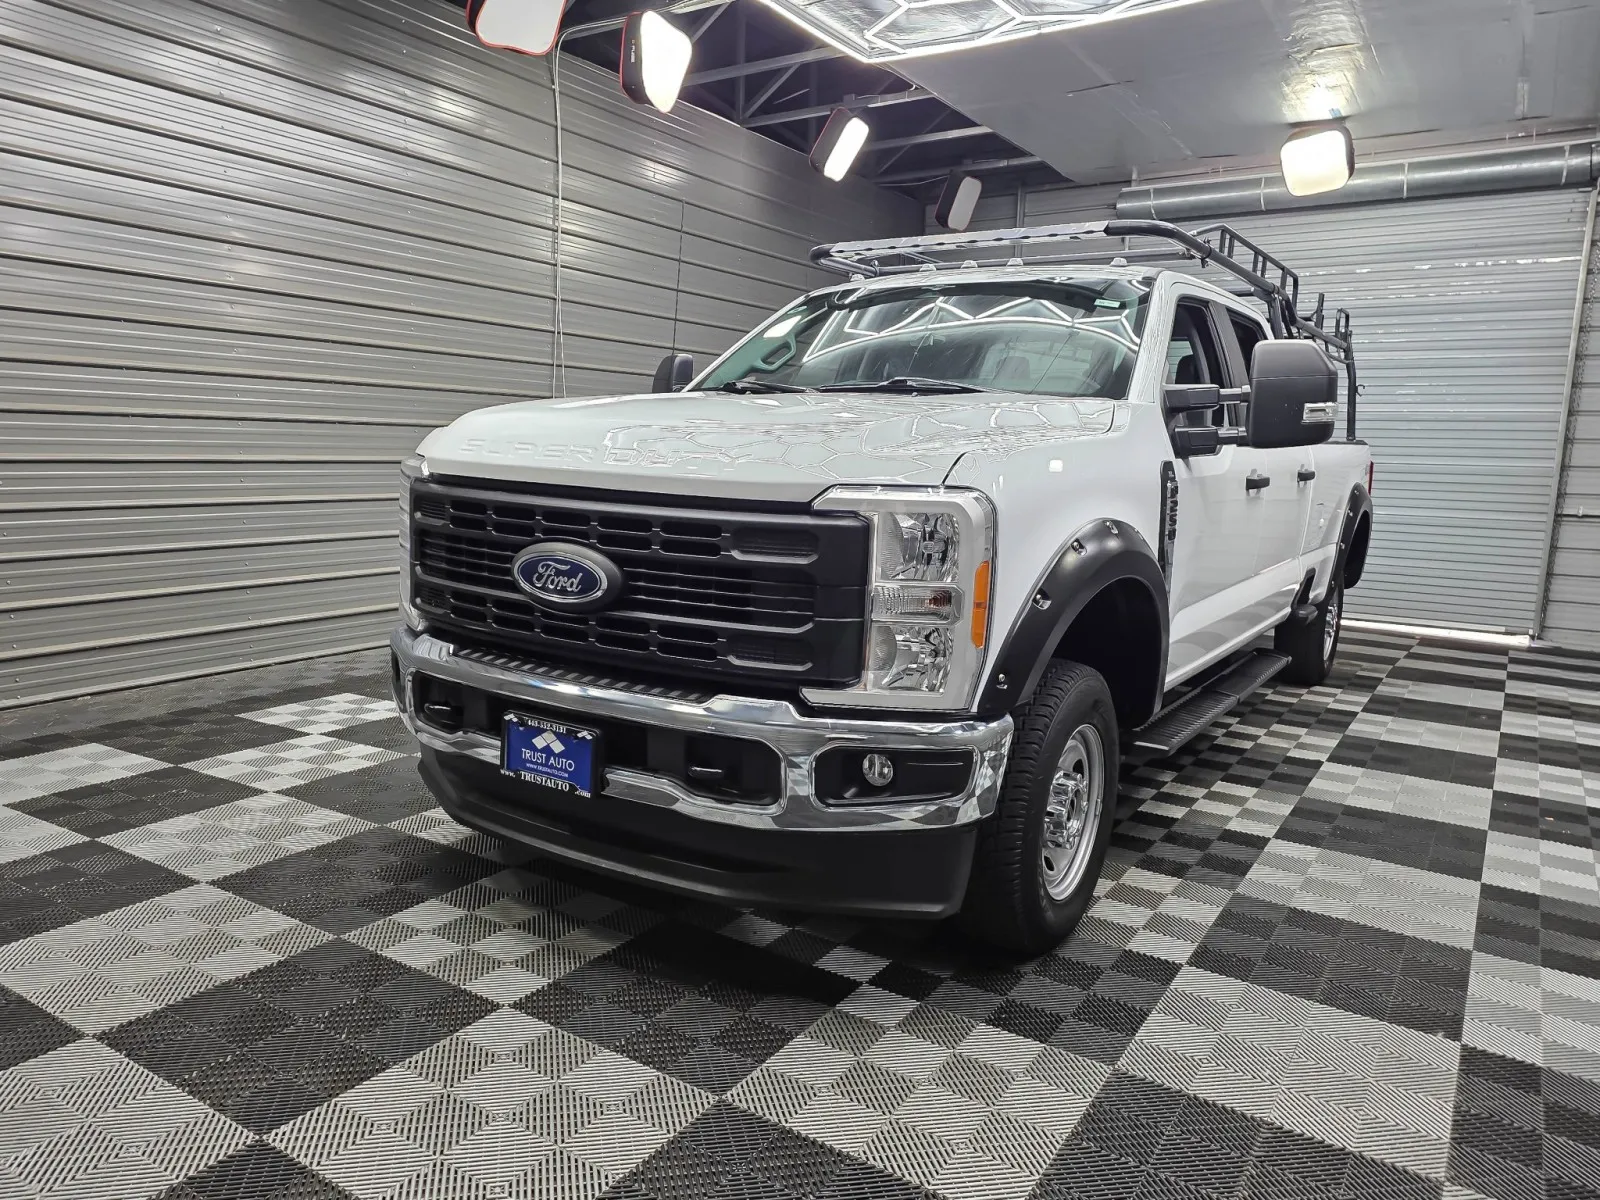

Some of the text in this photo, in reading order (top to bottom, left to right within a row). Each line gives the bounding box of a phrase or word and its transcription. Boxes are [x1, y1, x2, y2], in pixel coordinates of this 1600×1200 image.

[458, 438, 598, 463] SUPER
[533, 561, 583, 592] Ford
[521, 748, 575, 771] TRUST AUTO
[519, 771, 570, 791] TRUSTAUTO
